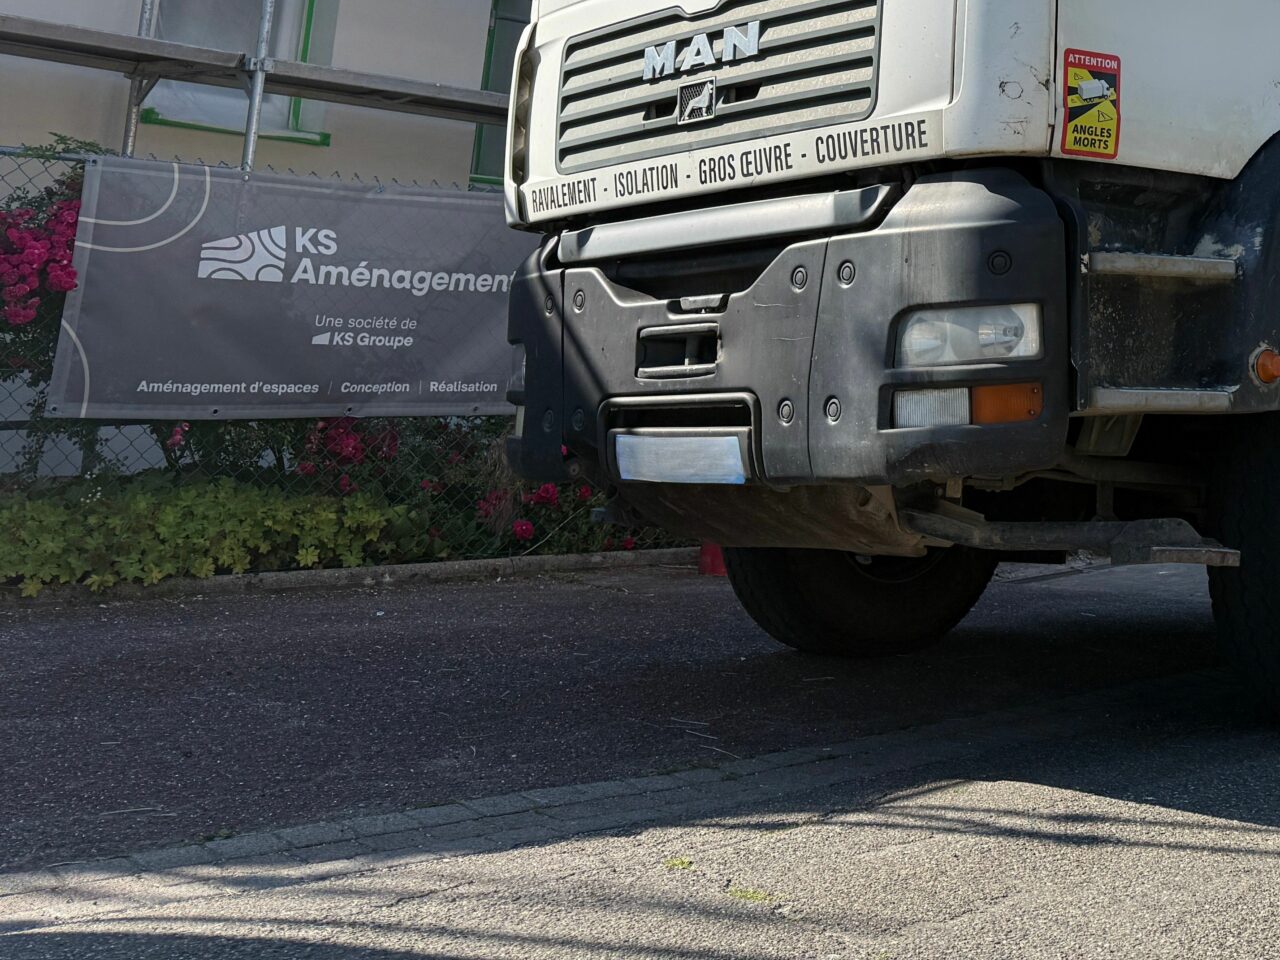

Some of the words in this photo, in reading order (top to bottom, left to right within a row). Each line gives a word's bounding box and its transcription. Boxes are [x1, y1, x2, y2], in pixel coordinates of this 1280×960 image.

[642, 20, 761, 81] MAN
[1068, 53, 1118, 70] ATTENTION
[1072, 123, 1112, 138] ANGLES
[1072, 135, 1110, 150] MORTS
[531, 176, 598, 214] RAVALEMENT
[613, 162, 679, 199] ISOLATION
[698, 155, 736, 186] GROS
[738, 142, 793, 178] ŒUVRE
[815, 118, 929, 165] COUVERTURE
[295, 226, 338, 256] KS
[315, 314, 344, 328] Une
[347, 316, 398, 330] société
[400, 318, 418, 330] de
[333, 331, 354, 346] KS
[356, 333, 414, 349] Groupe
[136, 379, 247, 396] Aménagement
[340, 381, 411, 396] Conception
[429, 379, 498, 393] Réalisation
